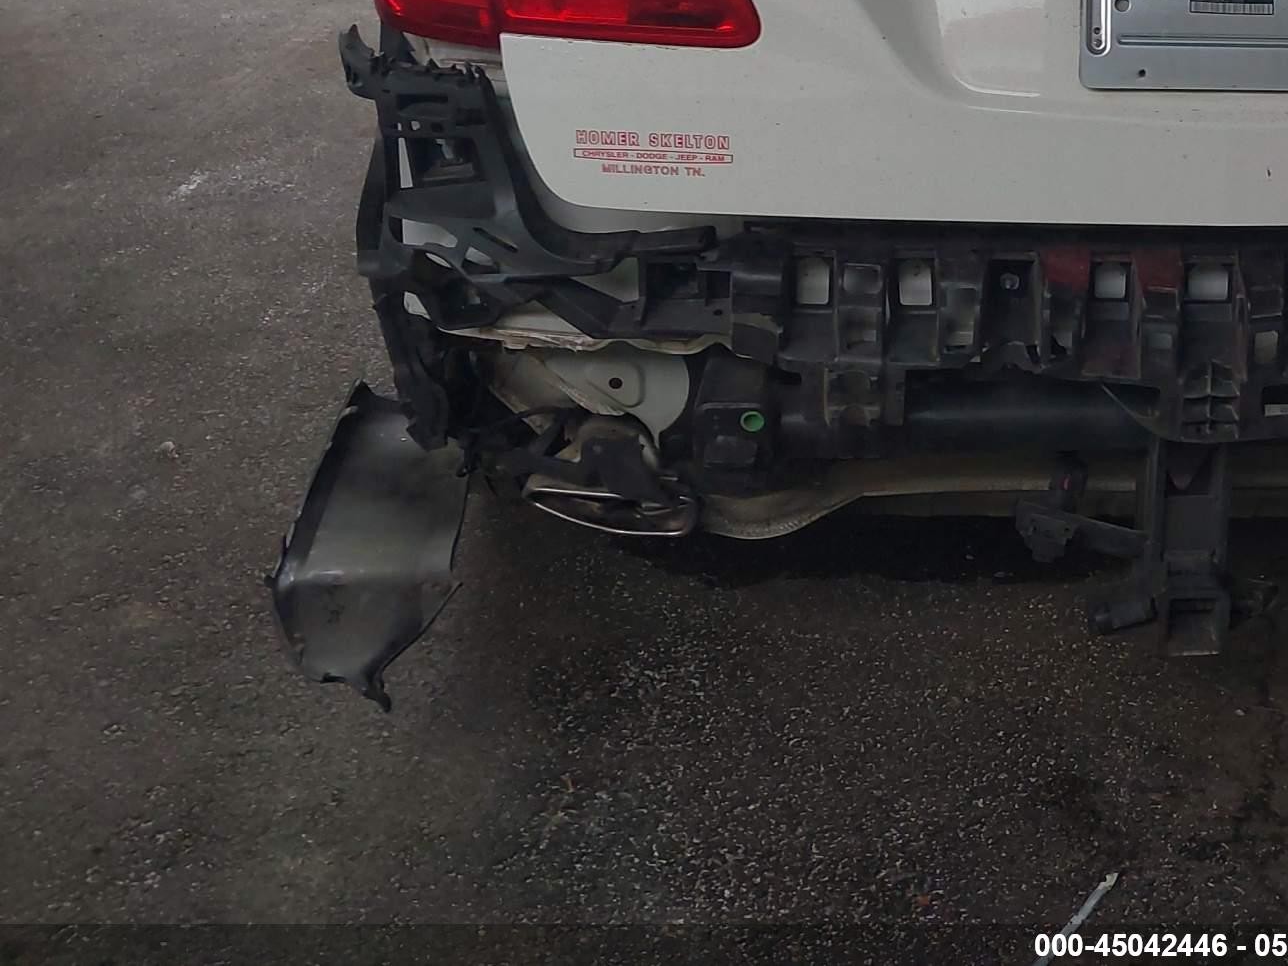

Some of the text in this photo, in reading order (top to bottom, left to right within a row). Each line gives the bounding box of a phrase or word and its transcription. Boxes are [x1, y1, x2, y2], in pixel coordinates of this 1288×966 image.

[576, 129, 730, 150] HOMER SKELTON
[581, 150, 629, 159] CHRYSLER
[636, 152, 667, 161] DODGE
[603, 164, 706, 177] MILLINGTON TN.
